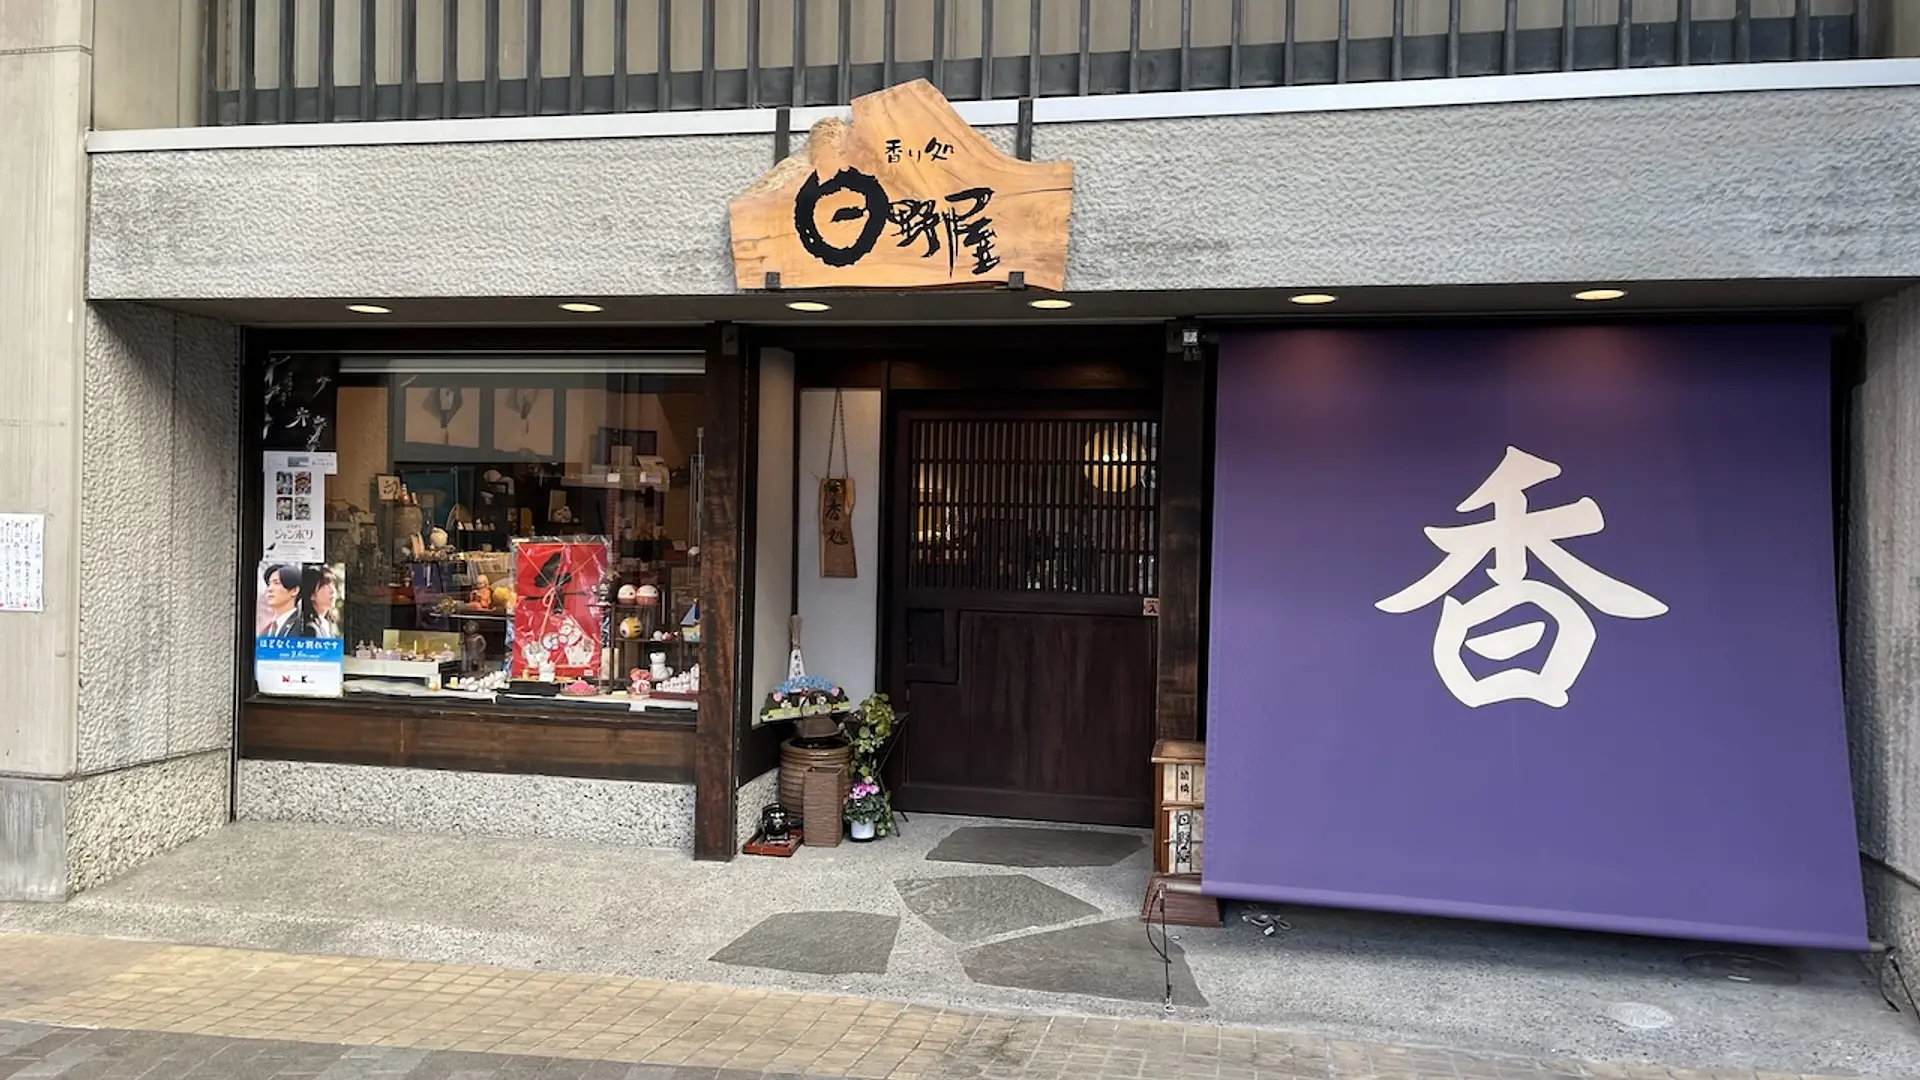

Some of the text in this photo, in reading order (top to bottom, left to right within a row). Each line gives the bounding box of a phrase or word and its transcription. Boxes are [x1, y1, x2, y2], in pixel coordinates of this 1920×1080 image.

[884, 138, 955, 164] 香り処
[794, 166, 1001, 279] 日野屋
[1374, 445, 1670, 709] 香
[260, 639, 339, 650] ほどなく、お別れです
